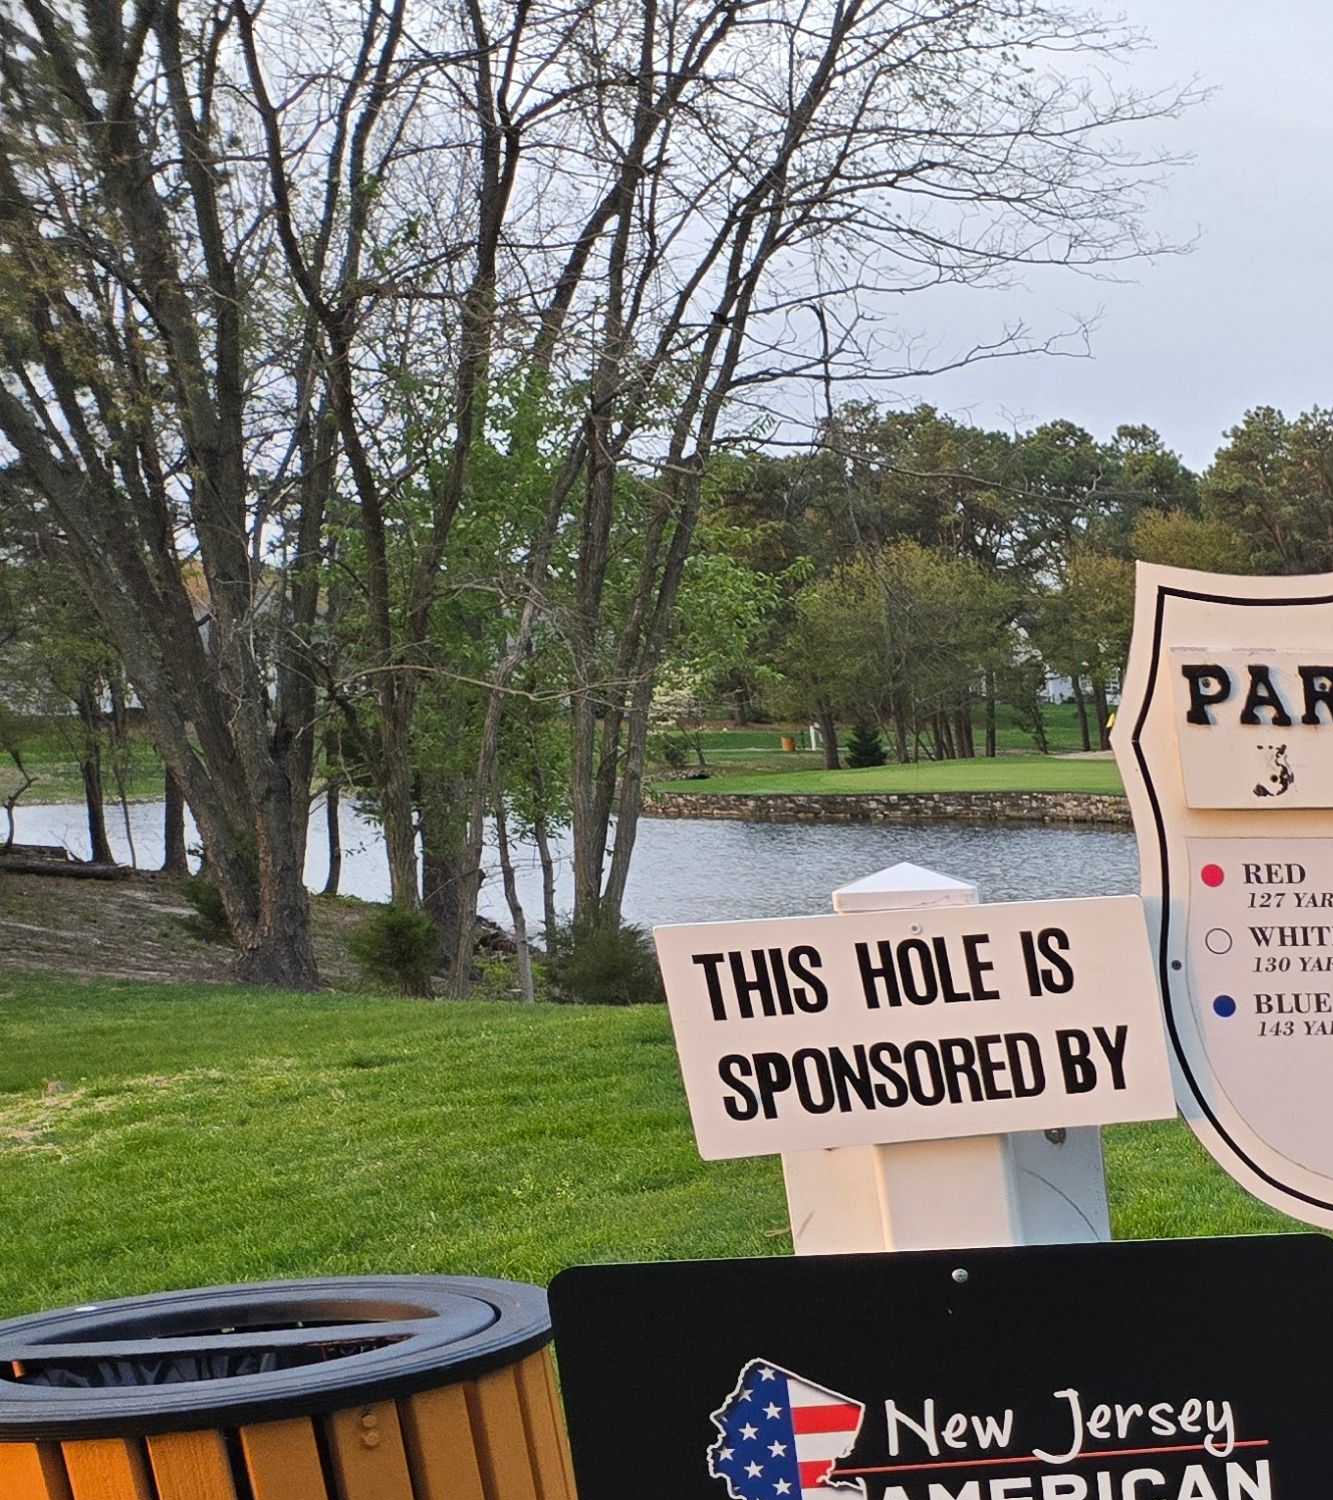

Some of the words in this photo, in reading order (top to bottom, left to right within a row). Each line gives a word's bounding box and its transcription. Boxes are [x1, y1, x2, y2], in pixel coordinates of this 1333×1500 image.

[1253, 743, 1294, 797] 3
[1242, 863, 1306, 884] RED
[1248, 892, 1283, 908] 127
[692, 945, 828, 1021] THIS
[854, 933, 1000, 1009] HOLE
[1020, 927, 1074, 997] IS
[1253, 956, 1290, 972] 130
[1254, 992, 1332, 1014] BLUE
[1258, 1021, 1294, 1036] 143
[718, 1031, 1046, 1121] SPONSORED
[1055, 1025, 1128, 1095] BY
[885, 1398, 1014, 1457] New
[1032, 1388, 1237, 1465] Jersey
